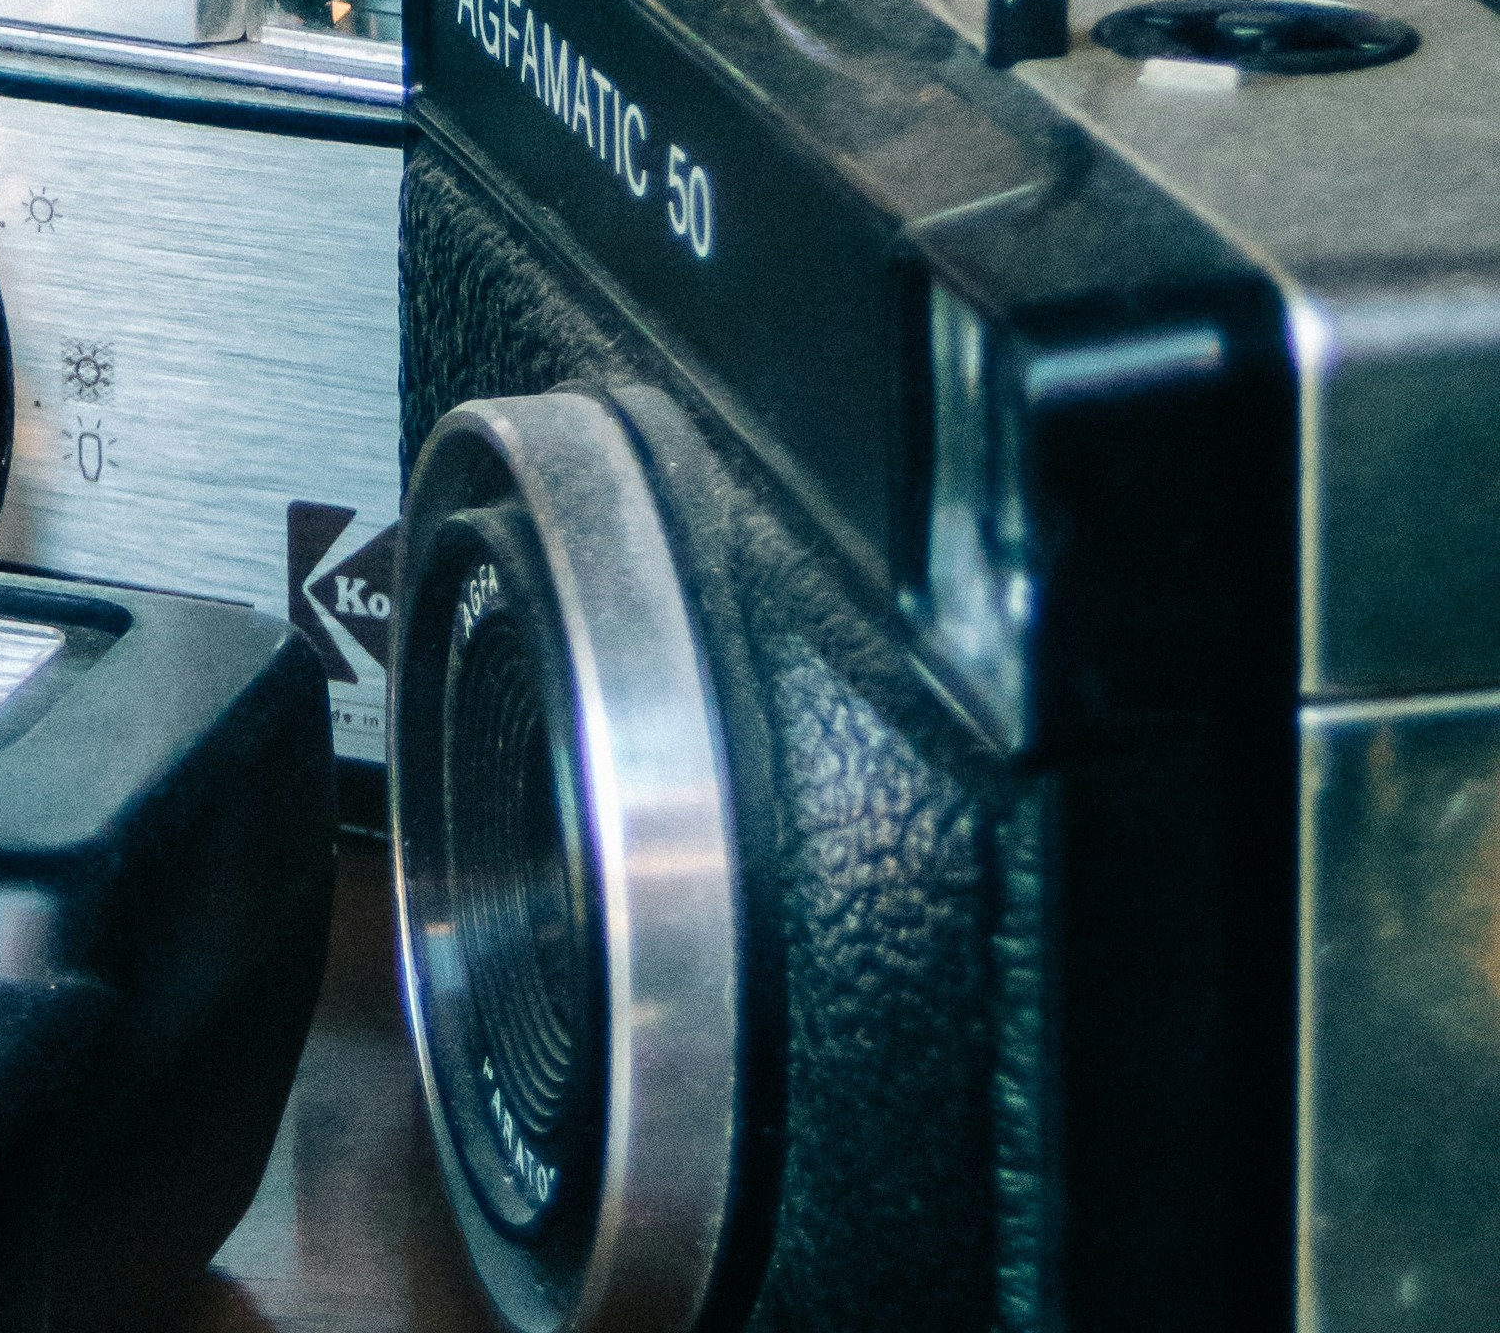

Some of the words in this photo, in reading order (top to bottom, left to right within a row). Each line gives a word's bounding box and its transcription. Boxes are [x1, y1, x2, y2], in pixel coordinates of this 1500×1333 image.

[667, 143, 711, 259] 50
[333, 574, 392, 620] Ko
[459, 563, 499, 639] AGFA
